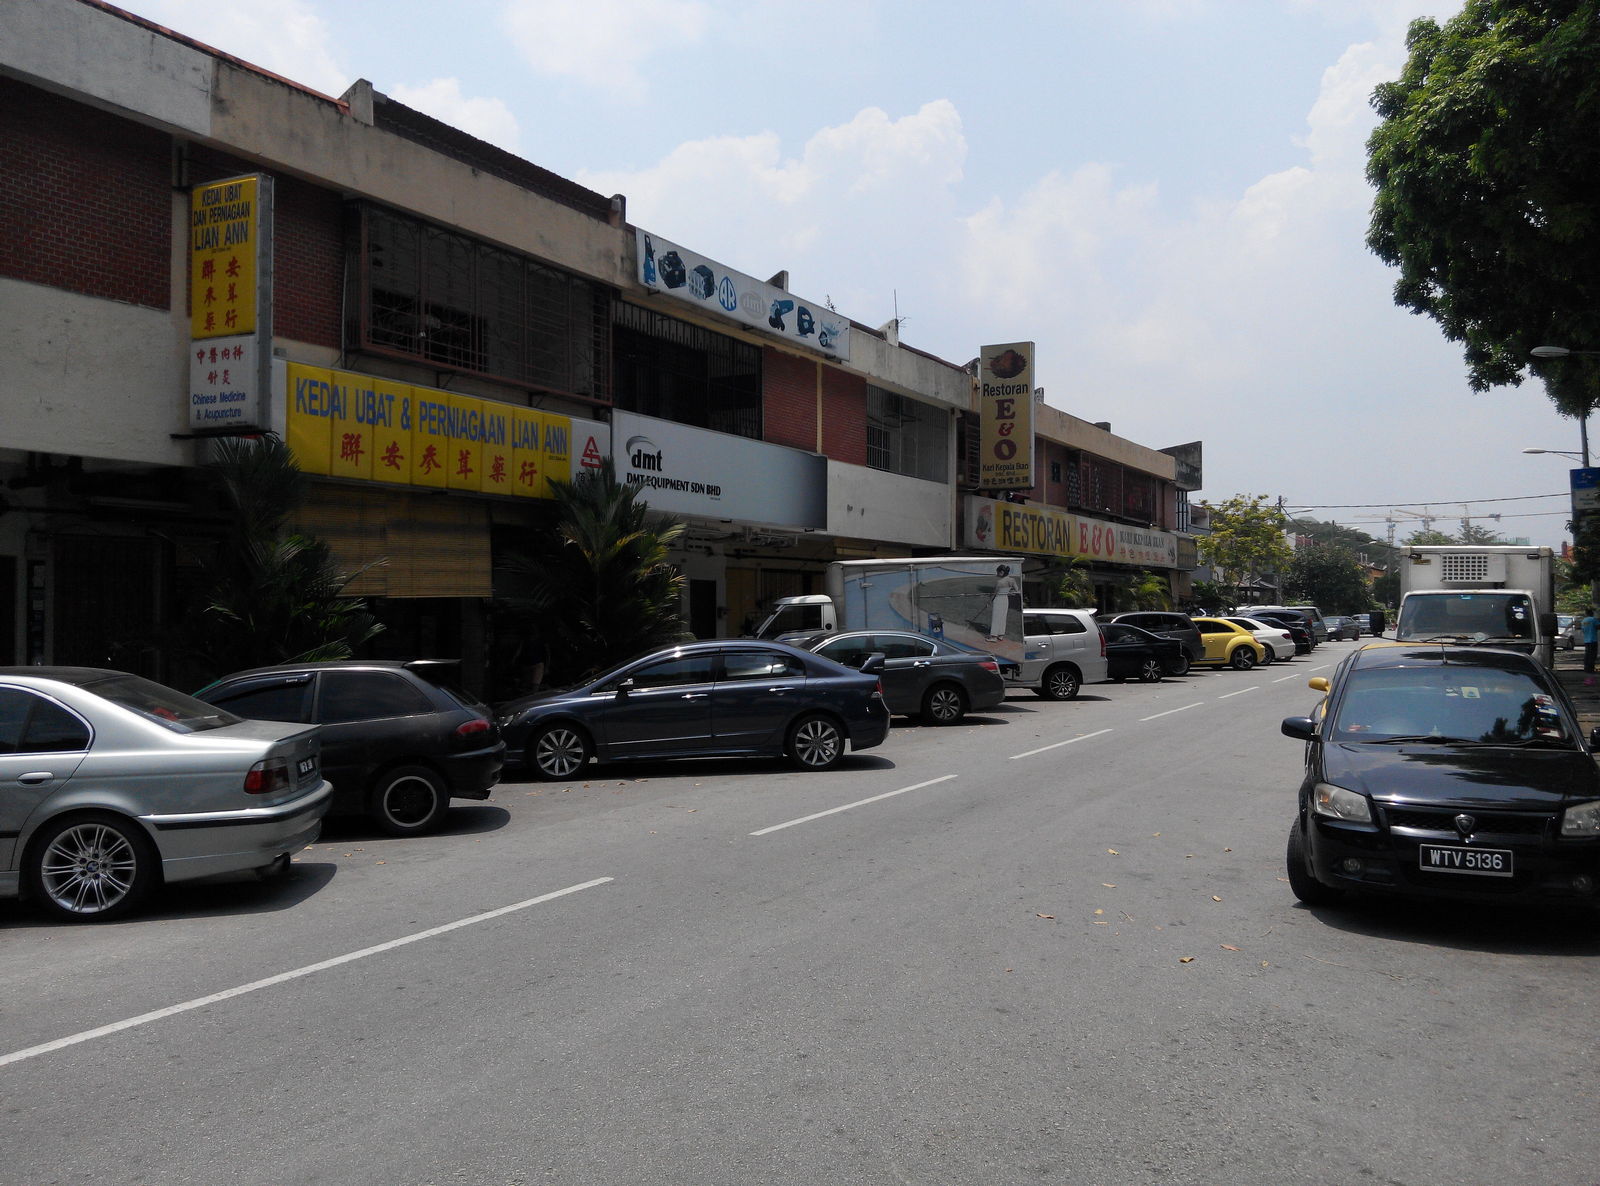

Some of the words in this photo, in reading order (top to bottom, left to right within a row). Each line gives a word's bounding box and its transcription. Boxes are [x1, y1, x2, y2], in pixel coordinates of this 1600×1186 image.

[193, 208, 207, 226] DAN
[209, 201, 251, 223] PERNIAGAAN
[194, 224, 219, 251] LIAN
[224, 220, 248, 246] ANN
[192, 393, 217, 405] Chinese
[219, 391, 247, 403] Medicine
[983, 383, 1029, 397] Restoran
[295, 376, 347, 421] KEDAI
[355, 389, 395, 428] UBAT
[401, 397, 411, 431] &
[419, 400, 506, 447] PERNIAGAAN
[512, 418, 539, 450] LIAN
[544, 424, 568, 456] ANN
[995, 398, 1016, 420] E
[998, 422, 1015, 436] &
[631, 449, 663, 472] dmt
[993, 438, 1017, 461] O
[691, 482, 705, 495] SDN
[706, 485, 721, 497] BHD
[1002, 509, 1070, 553] RESTORAN
[1430, 849, 1462, 868] WTV
[1465, 852, 1503, 870] 5136
